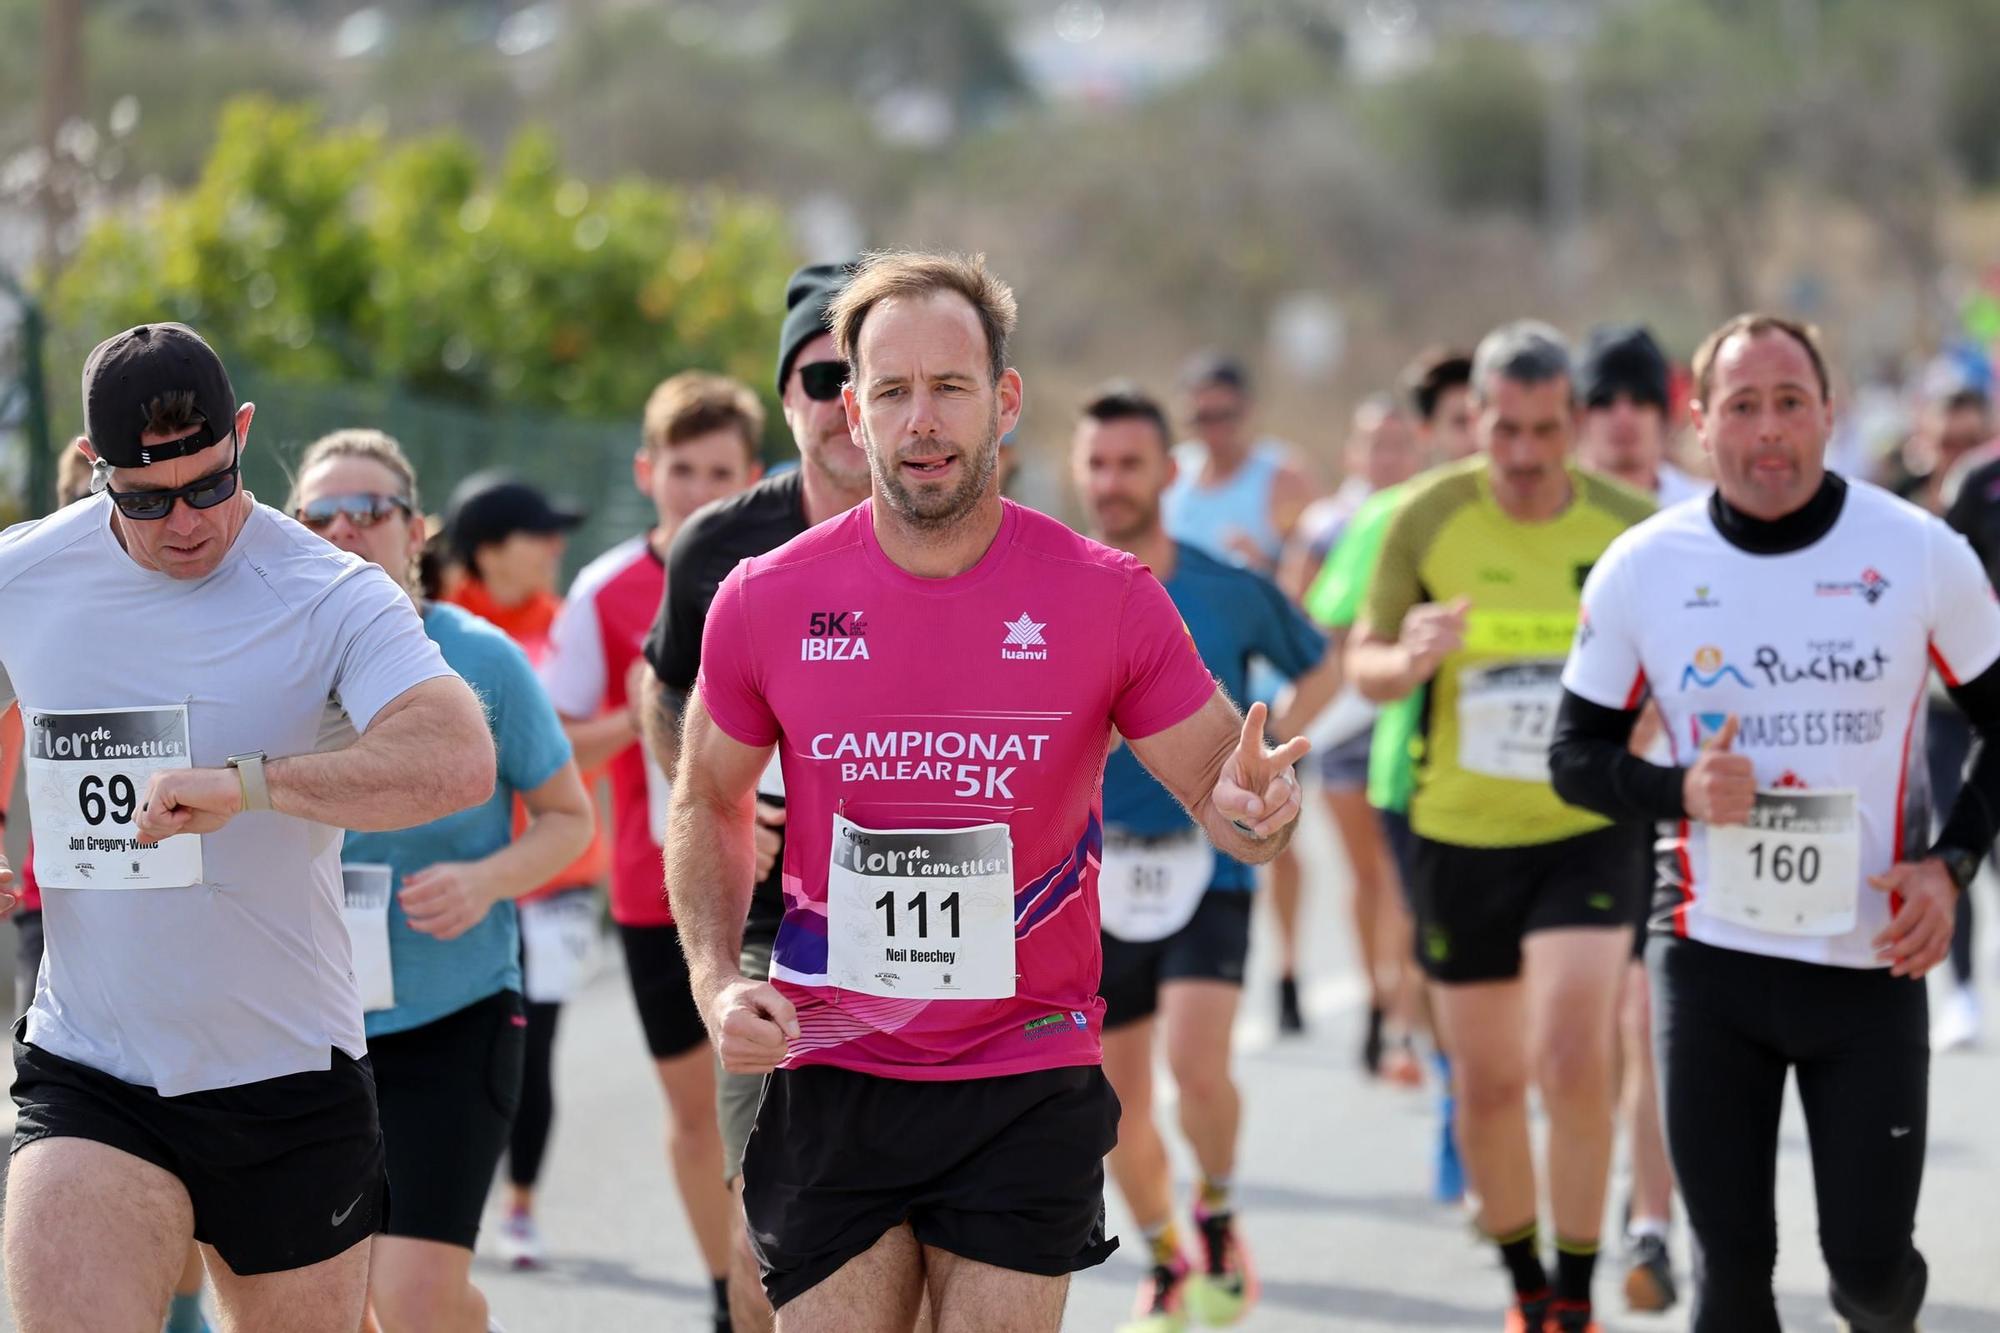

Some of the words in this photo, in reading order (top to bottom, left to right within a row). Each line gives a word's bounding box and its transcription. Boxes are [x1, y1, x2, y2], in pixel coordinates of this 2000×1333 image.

[809, 611, 850, 636] 5K
[801, 637, 870, 661] IBIZA
[1002, 649, 1047, 660] luanvi
[1754, 645, 1891, 686] Puchet
[33, 715, 57, 729] Cursa
[1804, 711, 1829, 746] ES
[33, 728, 89, 759] Flor
[90, 726, 112, 741] de
[811, 731, 1050, 761] CAMPIONAT
[841, 761, 952, 783] BALEAR
[955, 764, 1018, 799] 5K
[78, 773, 137, 826] 69
[68, 836, 85, 851] Jon
[842, 826, 871, 846] Cursa
[839, 842, 906, 875] Flor
[907, 845, 931, 859] de
[1748, 841, 1821, 884] 160
[875, 890, 960, 938] 111
[886, 948, 907, 962] Neil
[910, 949, 956, 965] Beechey
